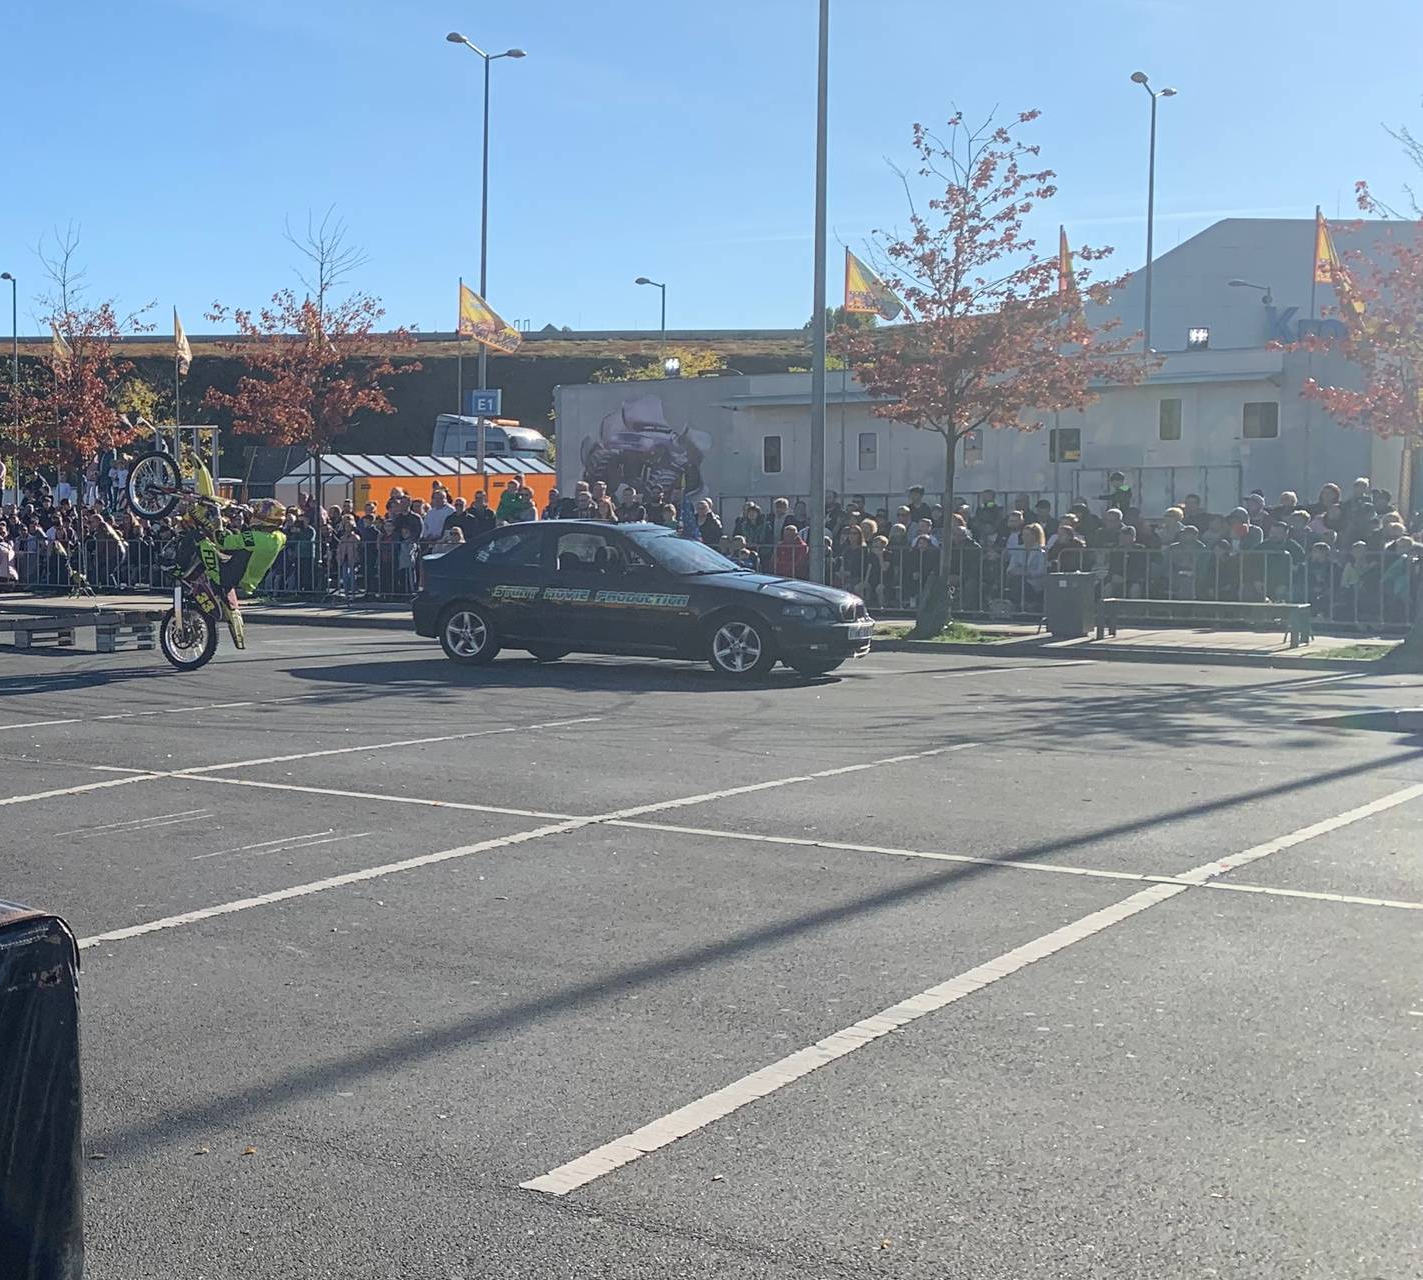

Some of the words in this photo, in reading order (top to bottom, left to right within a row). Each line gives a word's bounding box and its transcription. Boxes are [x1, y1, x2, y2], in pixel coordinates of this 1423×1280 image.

[478, 398, 493, 411] E1
[492, 584, 540, 599] STUNT
[543, 587, 591, 602] MOVIE
[595, 590, 690, 607] PRODUCTION
